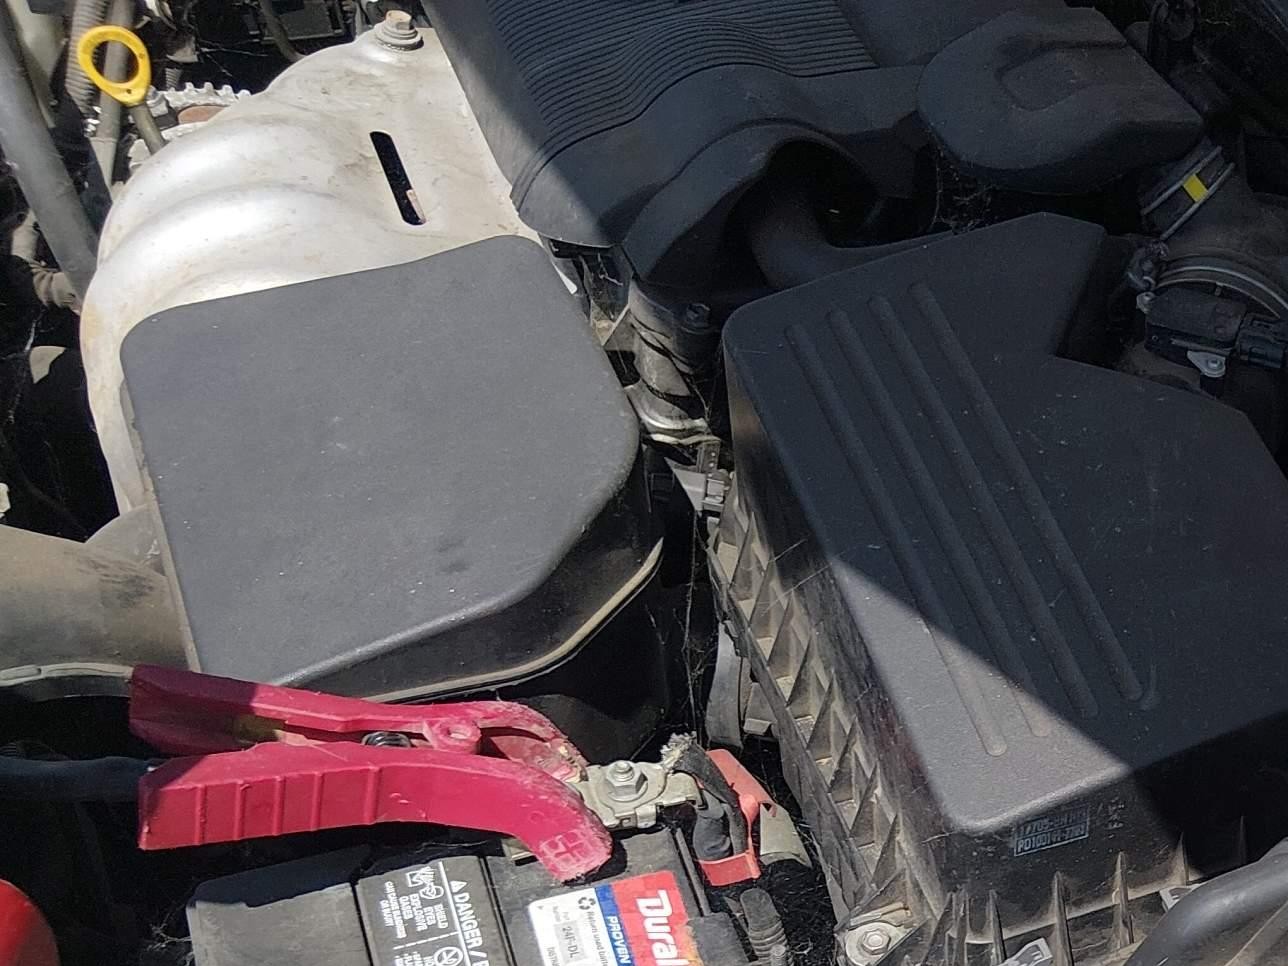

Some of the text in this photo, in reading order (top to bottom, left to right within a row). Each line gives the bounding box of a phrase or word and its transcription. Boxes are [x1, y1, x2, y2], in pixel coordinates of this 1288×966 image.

[406, 892, 428, 932] EXPLOSIVE
[423, 905, 436, 925] EYES
[432, 903, 449, 929] SHIELD
[452, 891, 483, 949] DANGER
[562, 926, 580, 958] 24F-DL
[593, 933, 604, 949] used
[606, 914, 630, 962] PROVEN
